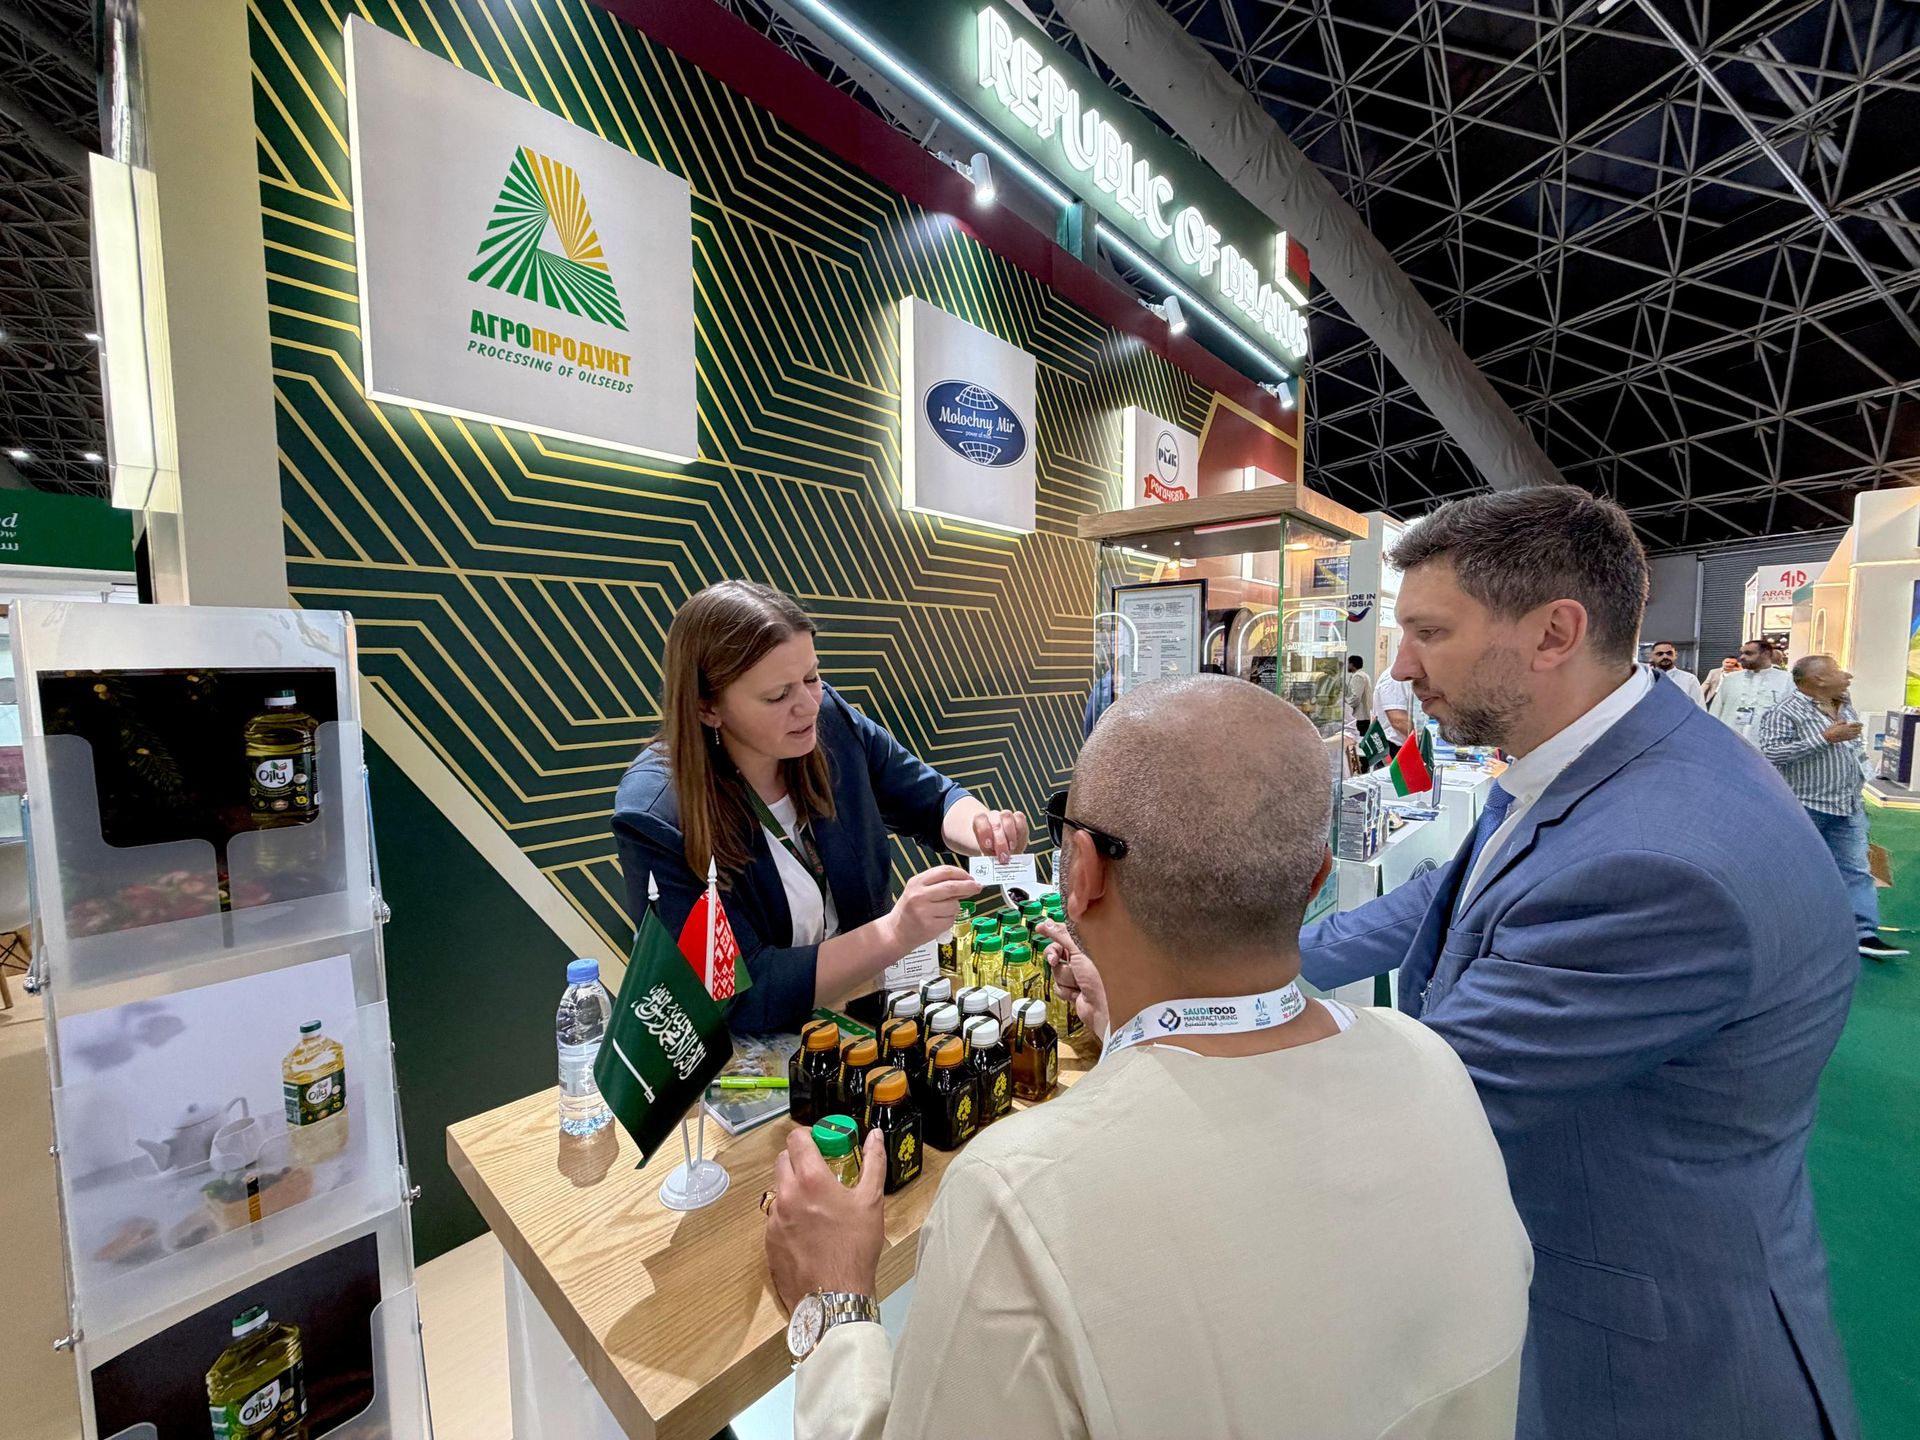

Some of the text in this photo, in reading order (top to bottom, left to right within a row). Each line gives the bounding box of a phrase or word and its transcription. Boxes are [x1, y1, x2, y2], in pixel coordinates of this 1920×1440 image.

[977, 5, 1308, 358] REPUBLIC OF BELARUS
[470, 309, 632, 377] АГРОПРОДУКТ
[467, 340, 634, 394] PROCESSING OF OILSEEDS
[938, 405, 1016, 436] Molochny Mir
[258, 769, 286, 784] Oily
[243, 1398, 273, 1420] Oily
